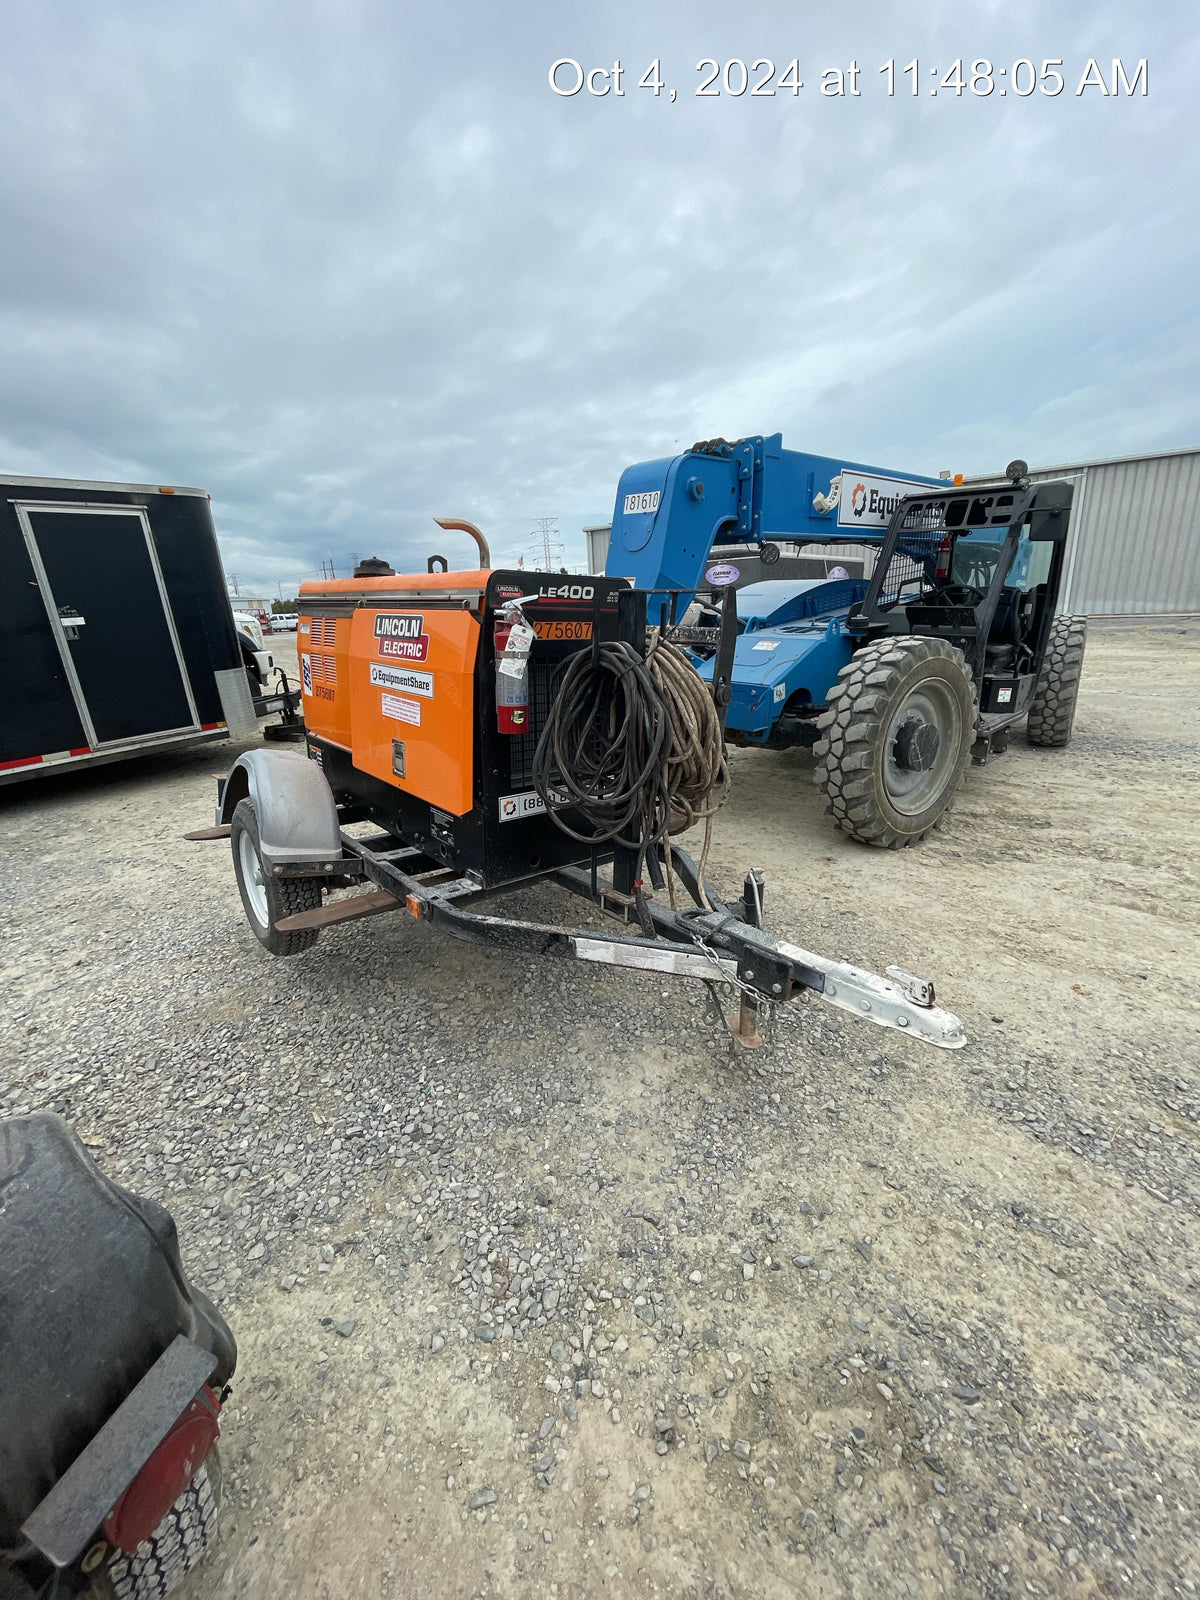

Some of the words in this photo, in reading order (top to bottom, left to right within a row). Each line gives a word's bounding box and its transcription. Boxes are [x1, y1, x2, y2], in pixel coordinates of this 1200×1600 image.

[625, 492, 659, 511] 181610
[868, 489, 902, 520] Equi
[539, 584, 595, 600] LE400
[376, 618, 420, 637] LINCOLN
[534, 622, 592, 639] 275607
[383, 640, 423, 658] ELECTRIC
[378, 670, 431, 691] EquipmentShare
